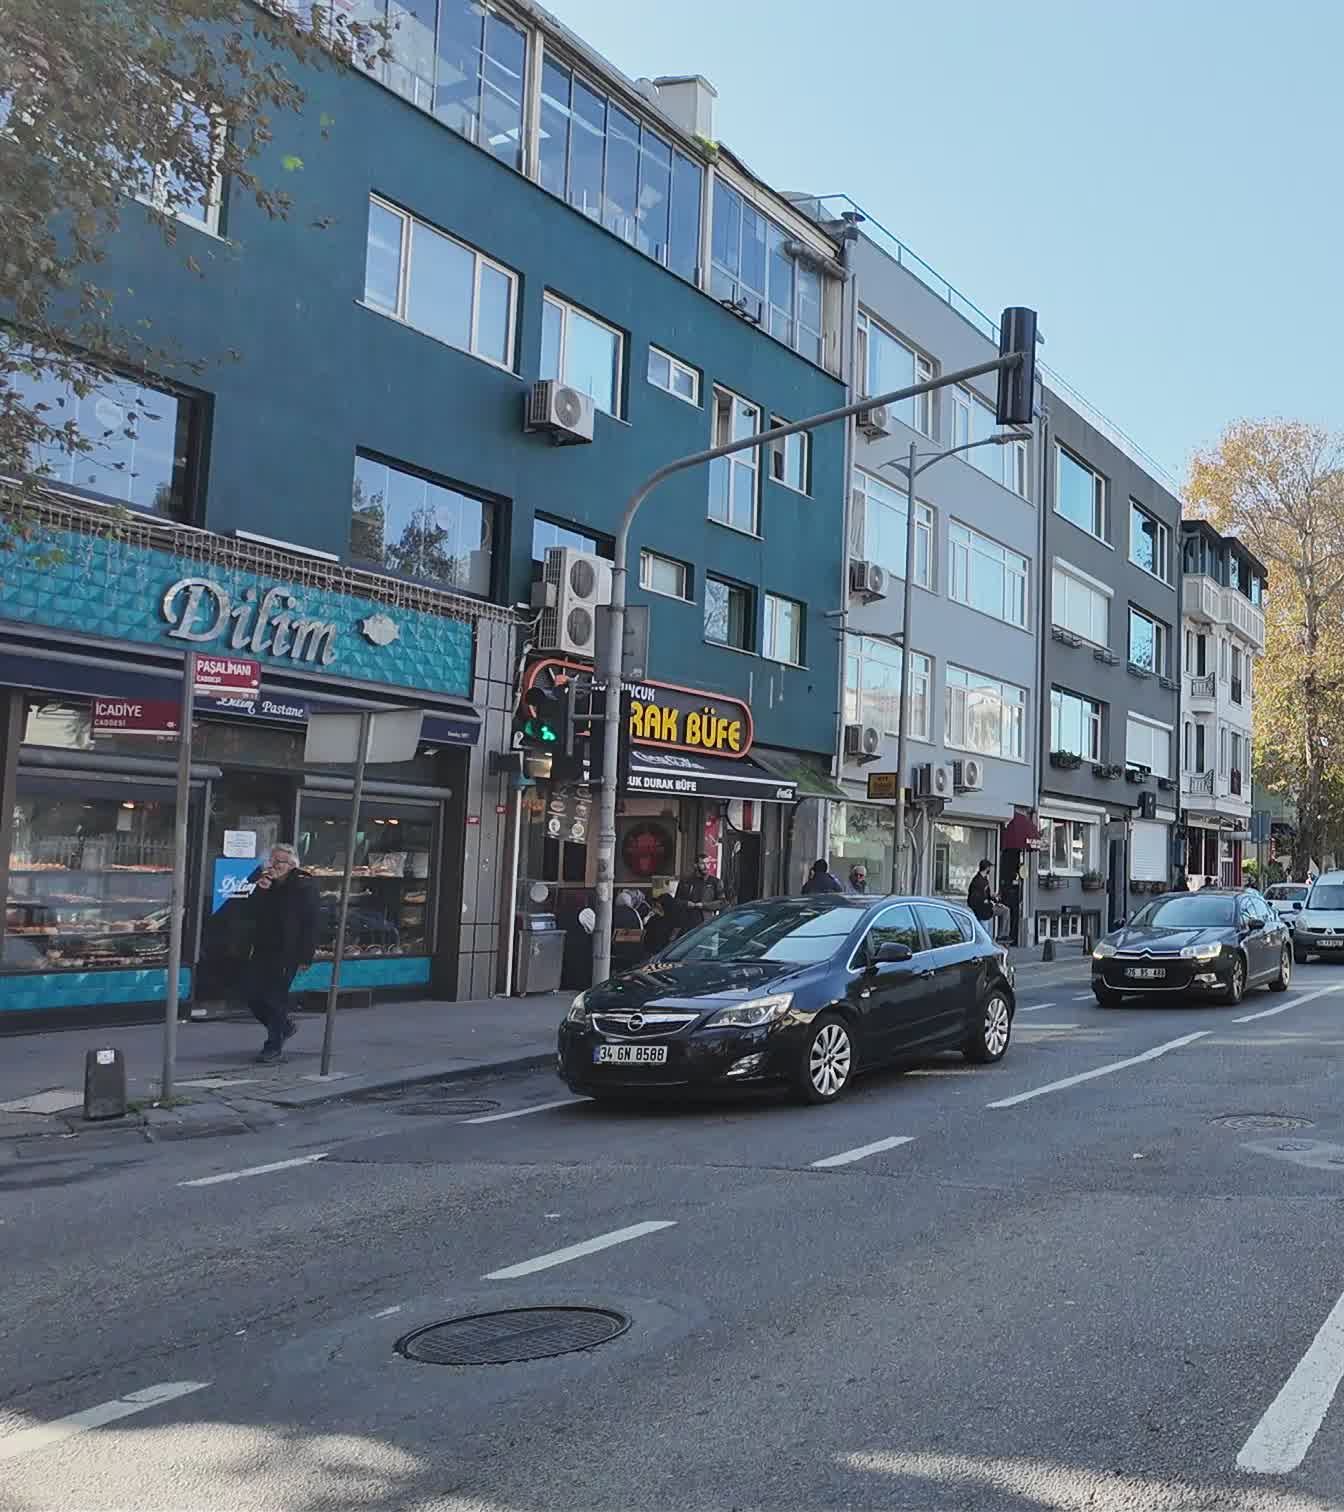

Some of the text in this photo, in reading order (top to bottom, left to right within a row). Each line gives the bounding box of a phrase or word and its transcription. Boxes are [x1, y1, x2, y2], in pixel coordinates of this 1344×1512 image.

[163, 577, 336, 665] Dilim
[95, 701, 142, 717] İCADİYE
[629, 701, 740, 751] RAK BÜFE
[643, 777, 674, 790] DURAK
[601, 1046, 613, 1060] 34
[617, 1047, 631, 1061] GN
